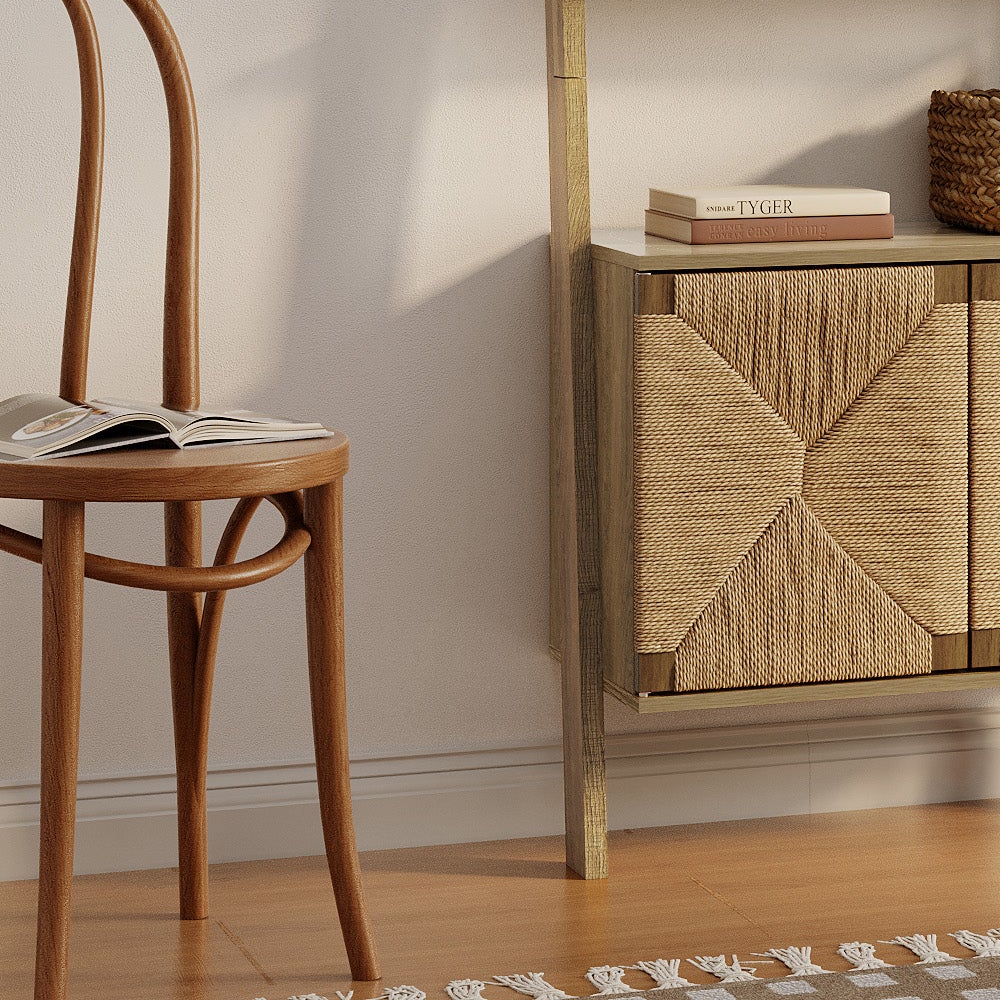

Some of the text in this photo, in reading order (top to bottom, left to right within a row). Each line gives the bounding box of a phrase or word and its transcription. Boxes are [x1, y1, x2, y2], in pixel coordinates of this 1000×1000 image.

[737, 199, 793, 215] TYGER
[746, 221, 829, 240] easy living
